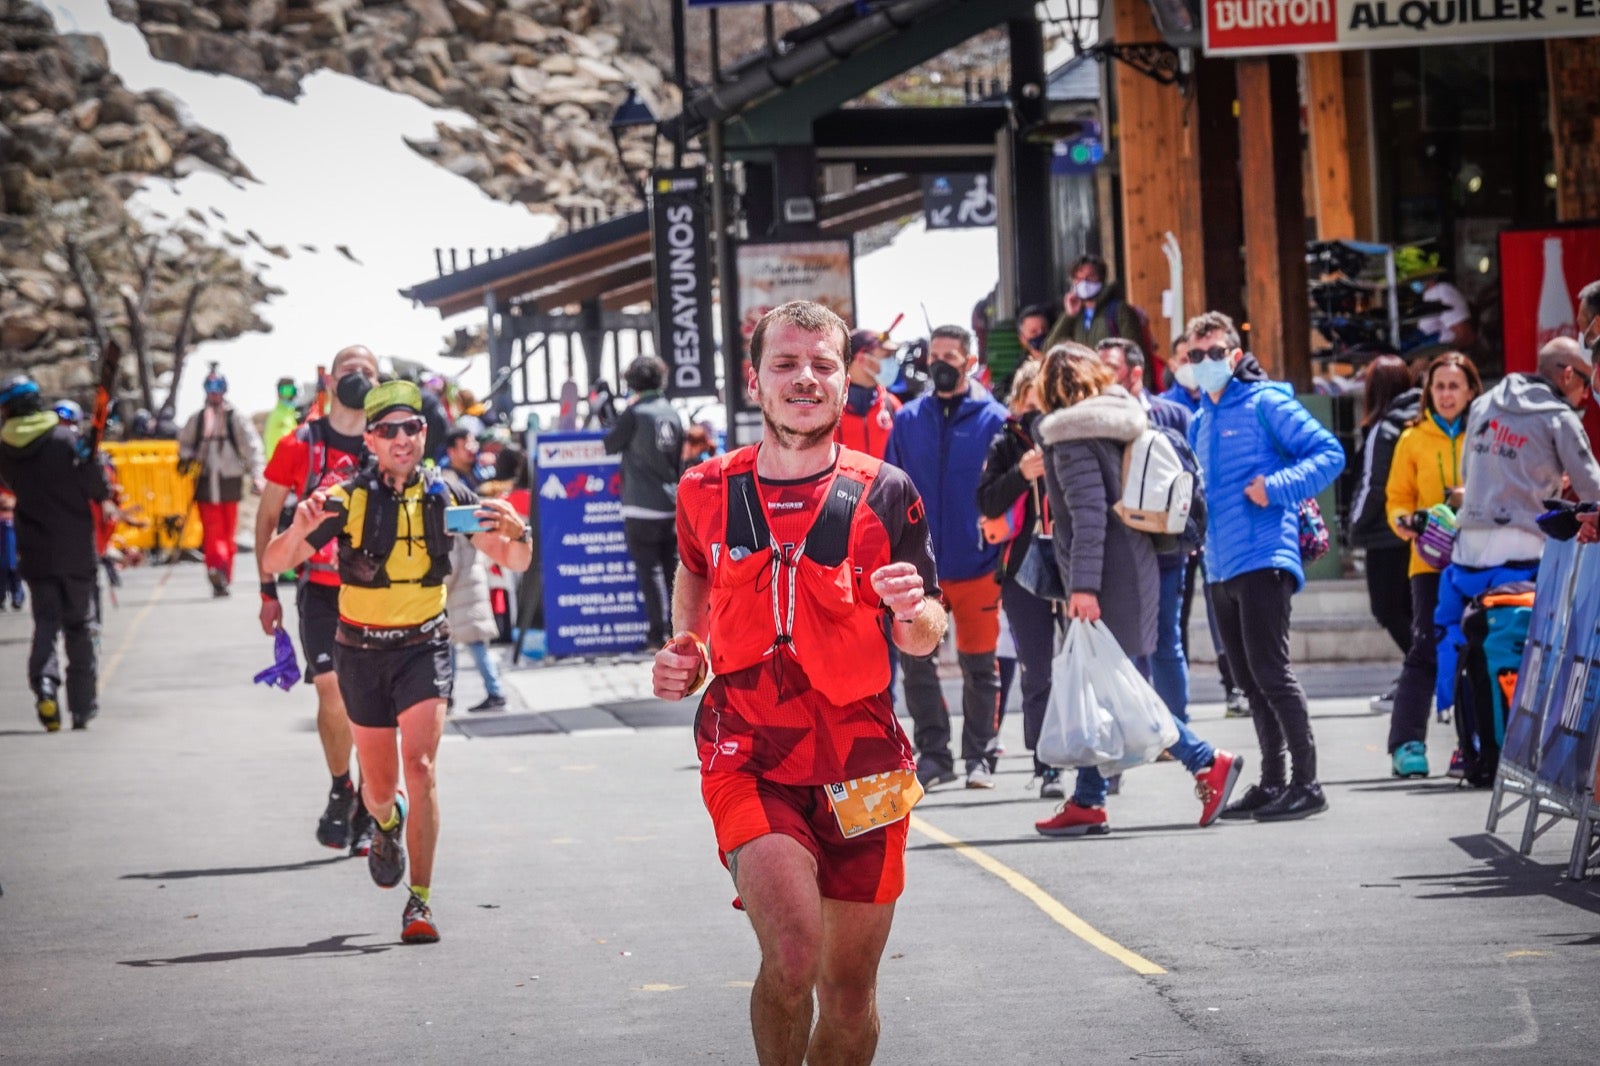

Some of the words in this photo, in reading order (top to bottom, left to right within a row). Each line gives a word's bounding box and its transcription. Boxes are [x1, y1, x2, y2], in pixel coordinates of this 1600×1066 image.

[1215, 0, 1331, 30] BURTON
[1349, 0, 1545, 30] ALQUILER
[667, 204, 701, 388] DESAYUNOS
[561, 532, 625, 546] ALQUILER
[557, 563, 605, 577] TALLER
[606, 562, 624, 574] DE
[558, 593, 616, 607] ESCUELA
[617, 592, 635, 603] DE
[558, 624, 601, 637] BOTAS
[602, 623, 612, 634] A
